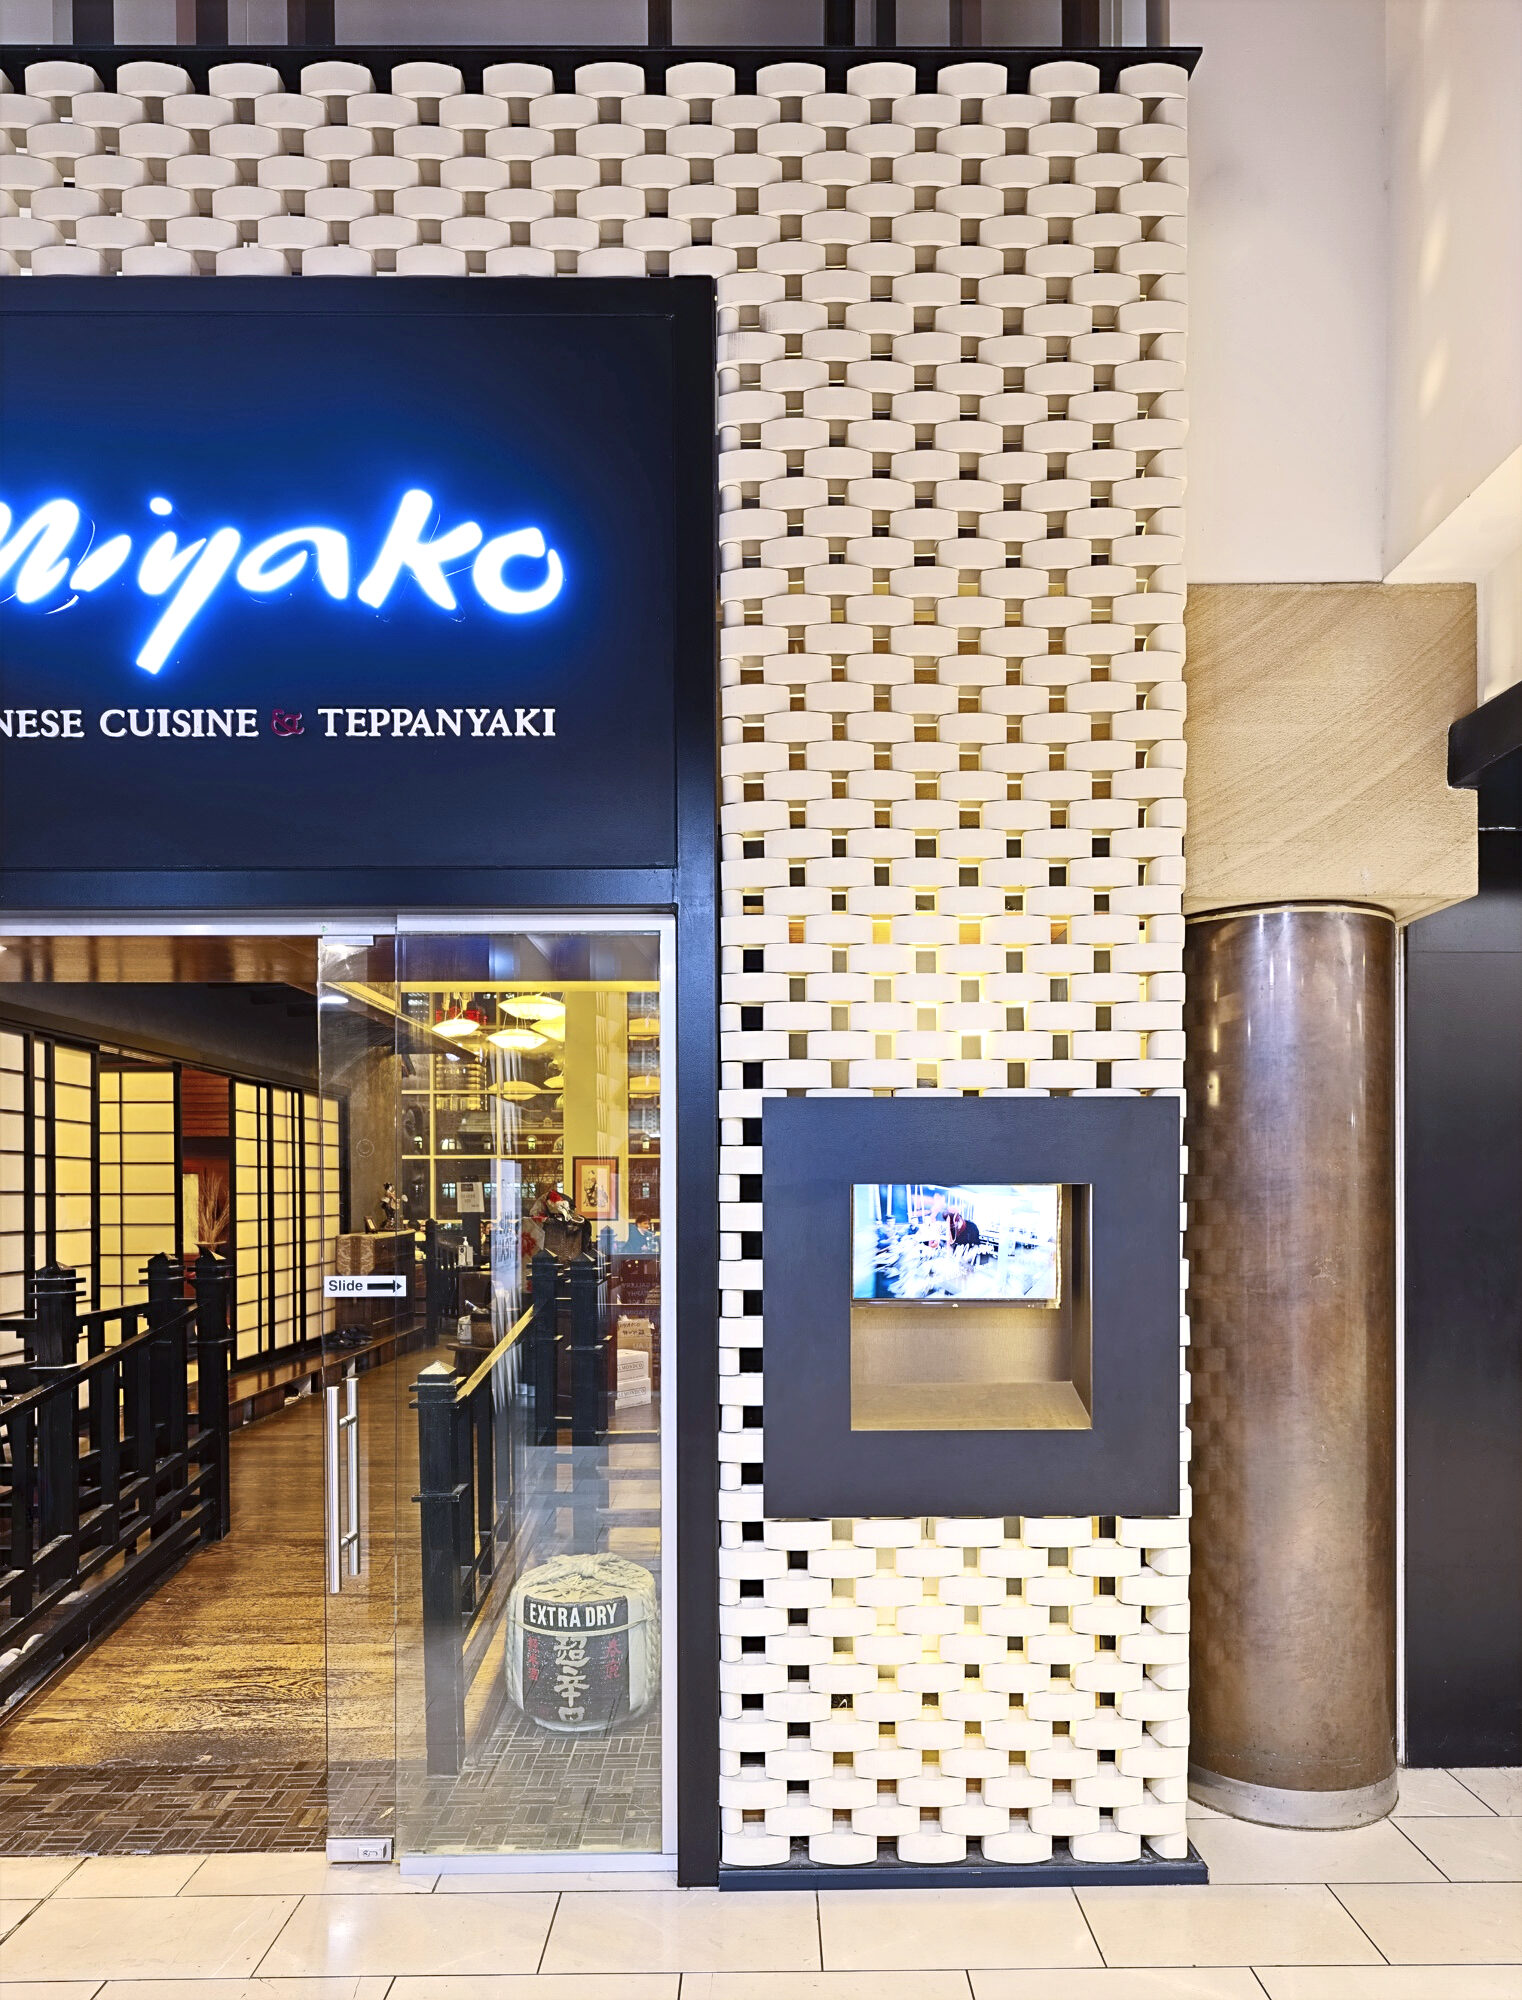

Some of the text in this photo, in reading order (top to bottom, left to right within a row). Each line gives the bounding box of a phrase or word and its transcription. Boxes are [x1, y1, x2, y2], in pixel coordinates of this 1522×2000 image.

[100, 708, 259, 738] CUISINE
[270, 708, 304, 737] &
[318, 708, 557, 738] TEPPANYAKI
[328, 1280, 363, 1292] Slide
[529, 1602, 618, 1628] EXTRA DRY
